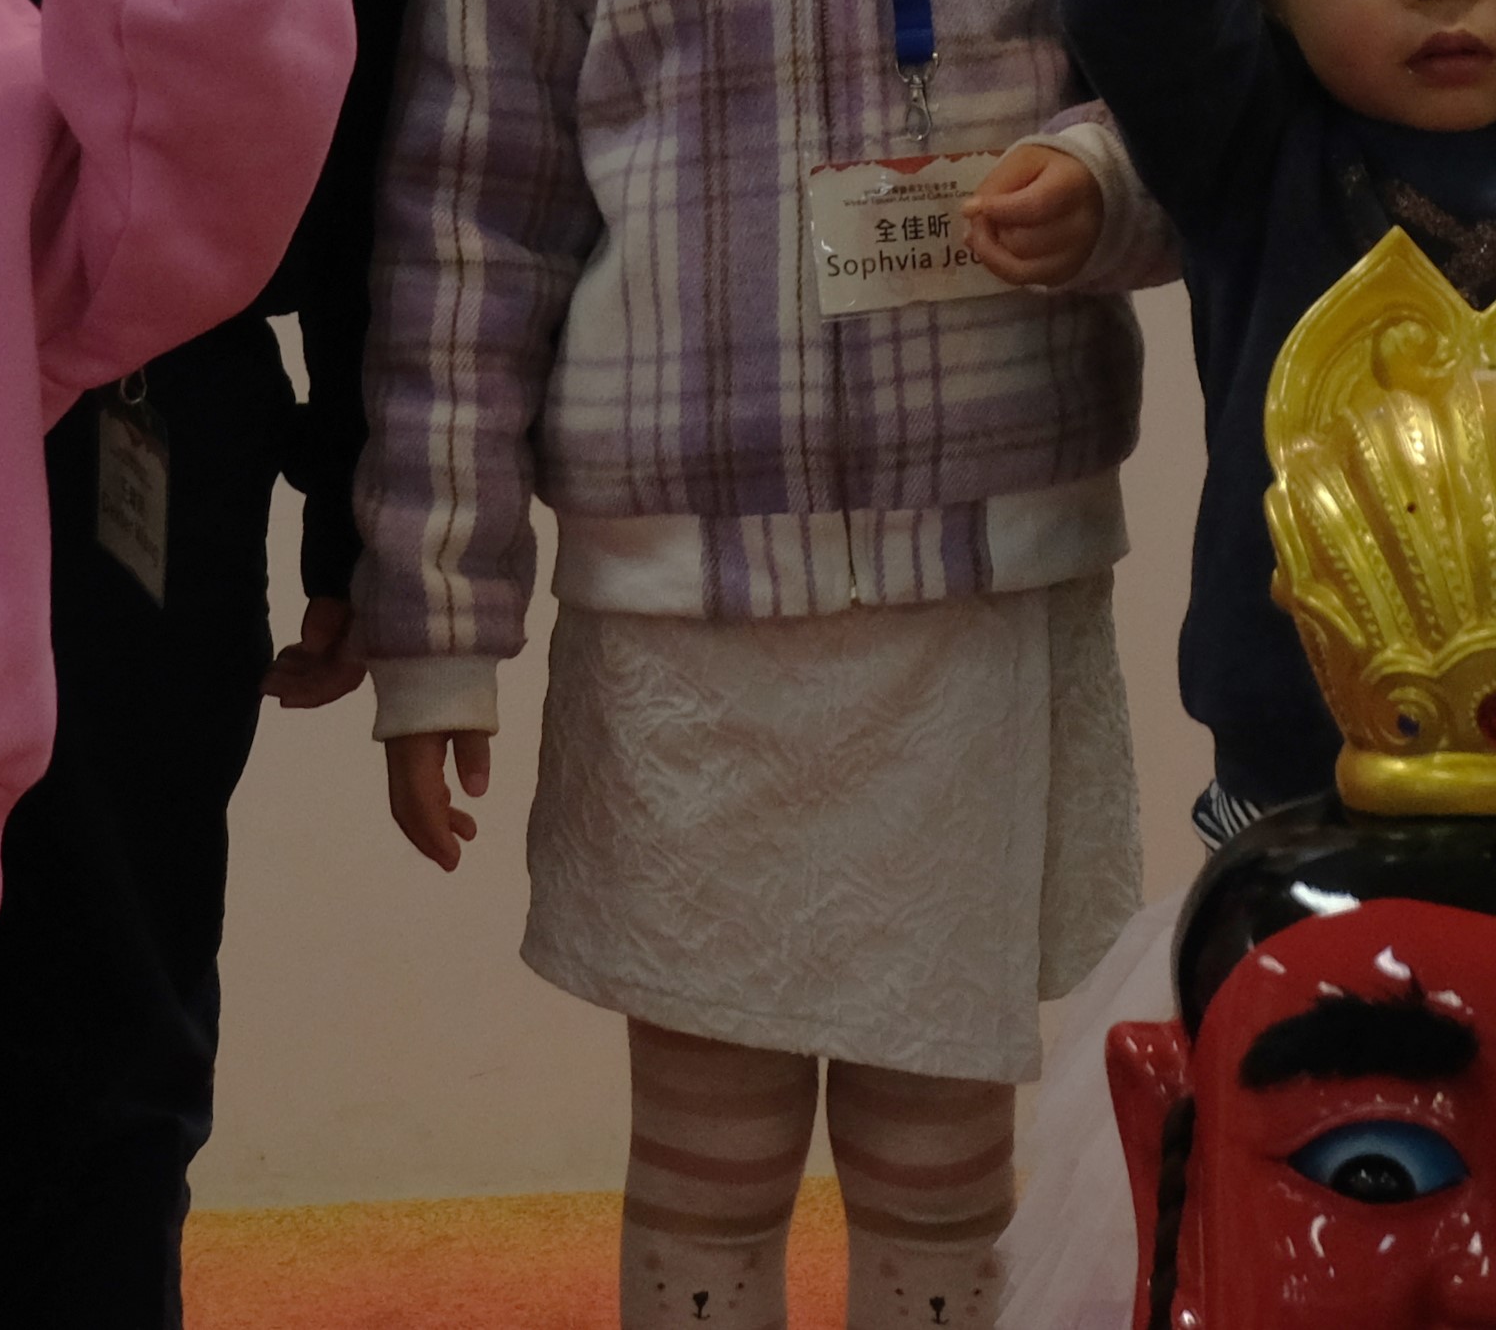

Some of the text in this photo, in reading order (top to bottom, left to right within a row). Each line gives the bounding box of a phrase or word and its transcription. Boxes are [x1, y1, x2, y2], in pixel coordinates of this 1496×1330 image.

[874, 213, 951, 244] 全佳昕
[826, 247, 932, 280] Sophvia
